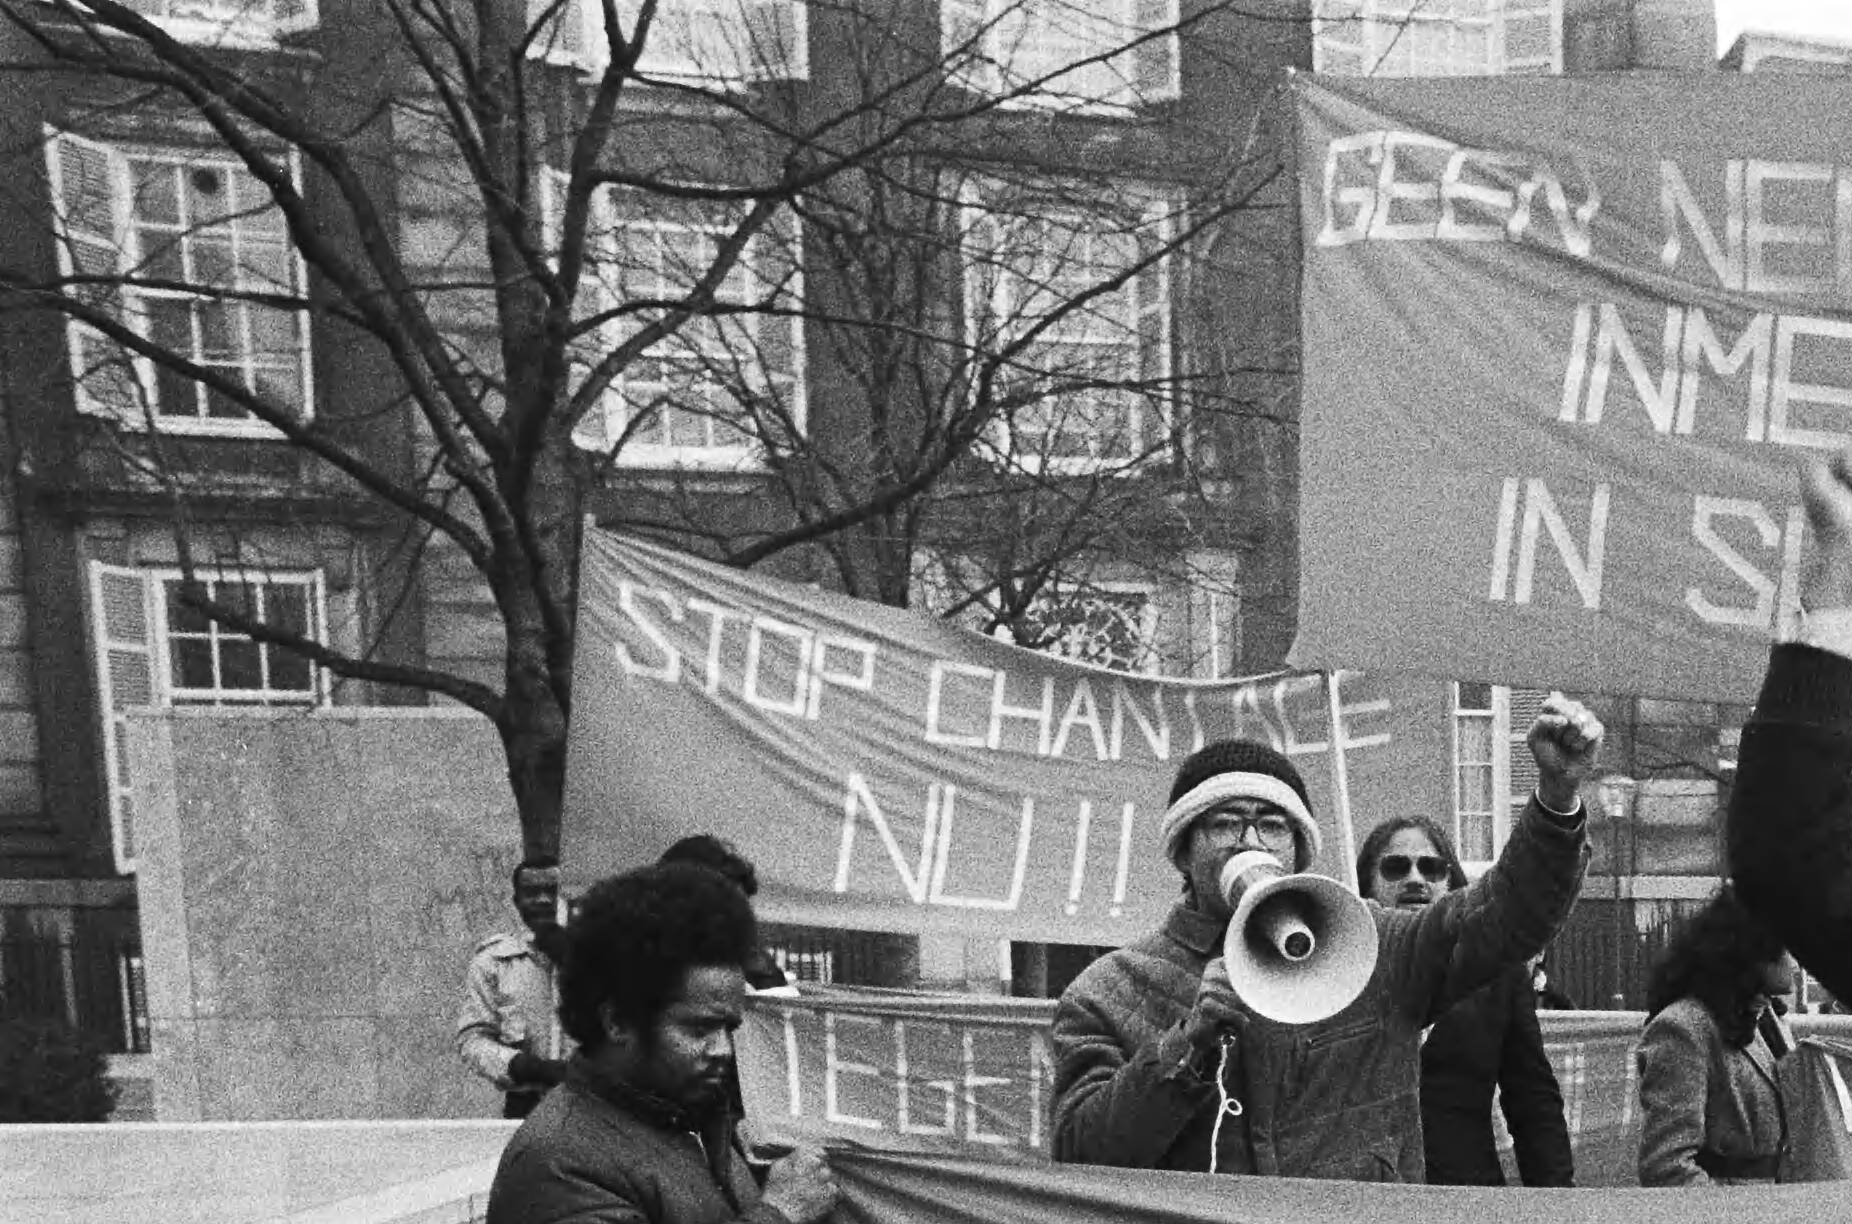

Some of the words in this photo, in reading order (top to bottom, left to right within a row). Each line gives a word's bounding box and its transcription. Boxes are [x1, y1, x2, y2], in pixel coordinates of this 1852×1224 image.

[1314, 130, 1597, 257] GEEN
[1489, 477, 1610, 609] IN
[614, 580, 878, 722] STOP
